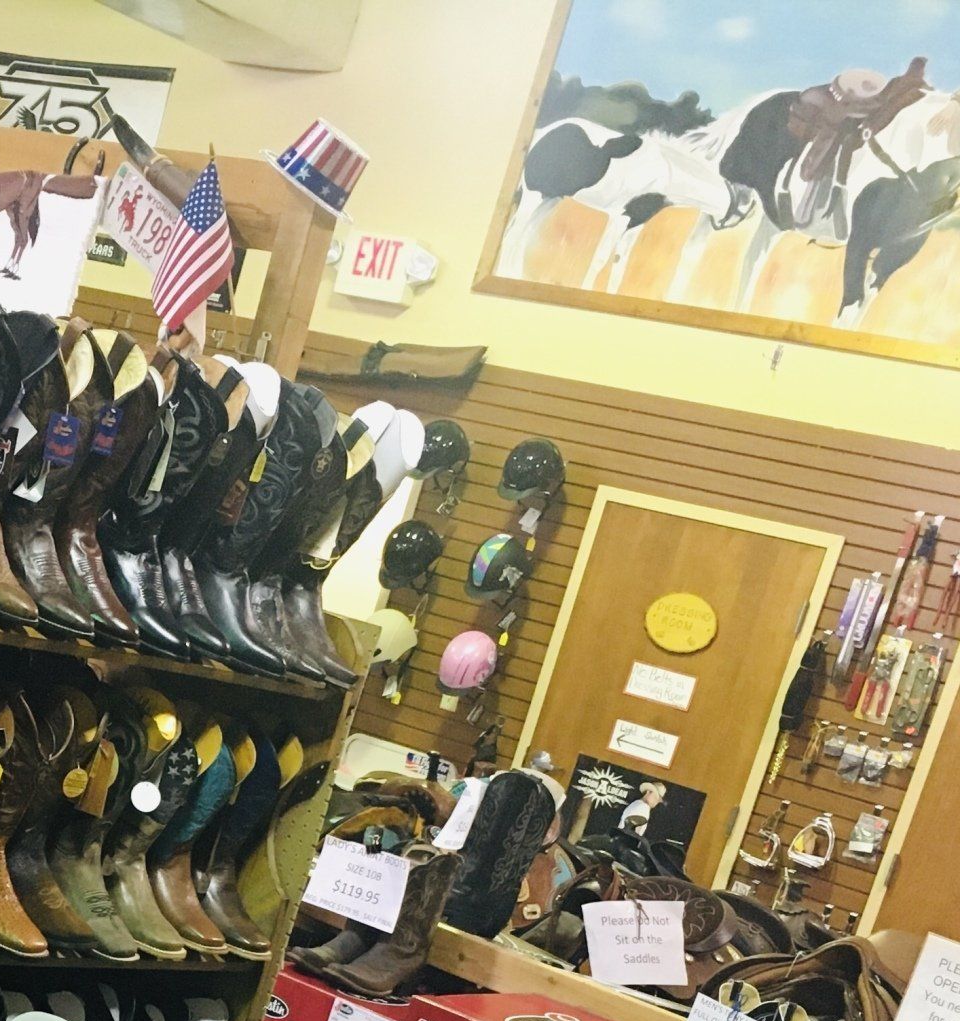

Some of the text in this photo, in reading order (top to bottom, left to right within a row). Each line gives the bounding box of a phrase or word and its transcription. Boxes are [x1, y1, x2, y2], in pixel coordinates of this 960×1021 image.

[127, 235, 153, 263] TRUCK
[352, 235, 404, 280] EXIT
[345, 862, 365, 877] SIZE
[384, 854, 407, 870] BOOTS
[332, 879, 381, 904] $119.95
[601, 914, 635, 926] Please
[652, 916, 669, 926] Not
[615, 934, 663, 945] Sit on the
[623, 954, 660, 964] Saddles
[924, 990, 945, 1007] You
